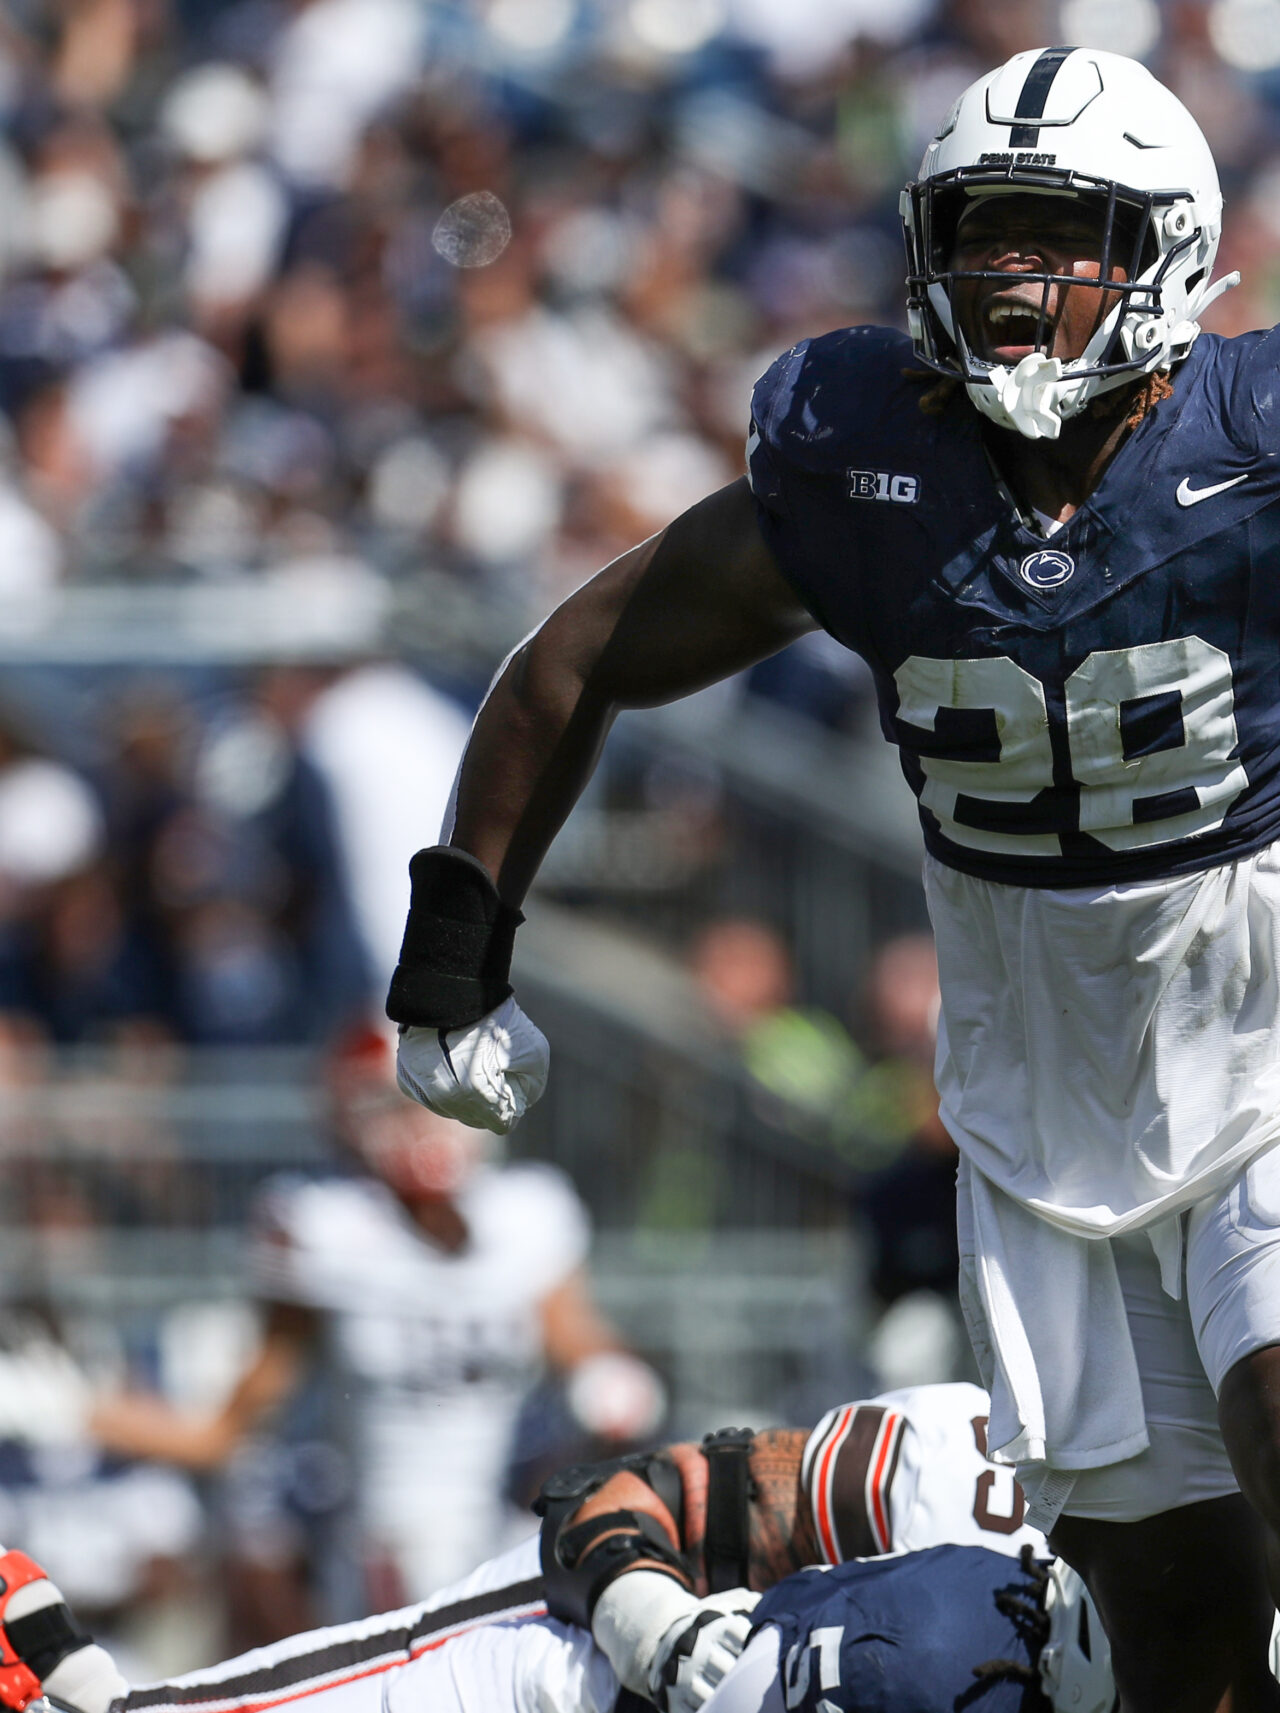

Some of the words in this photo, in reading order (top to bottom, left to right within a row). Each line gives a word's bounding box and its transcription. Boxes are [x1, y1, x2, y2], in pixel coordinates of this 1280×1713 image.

[980, 152, 1014, 164] PENN
[1016, 152, 1056, 165] STATE
[893, 635, 1249, 857] 28
